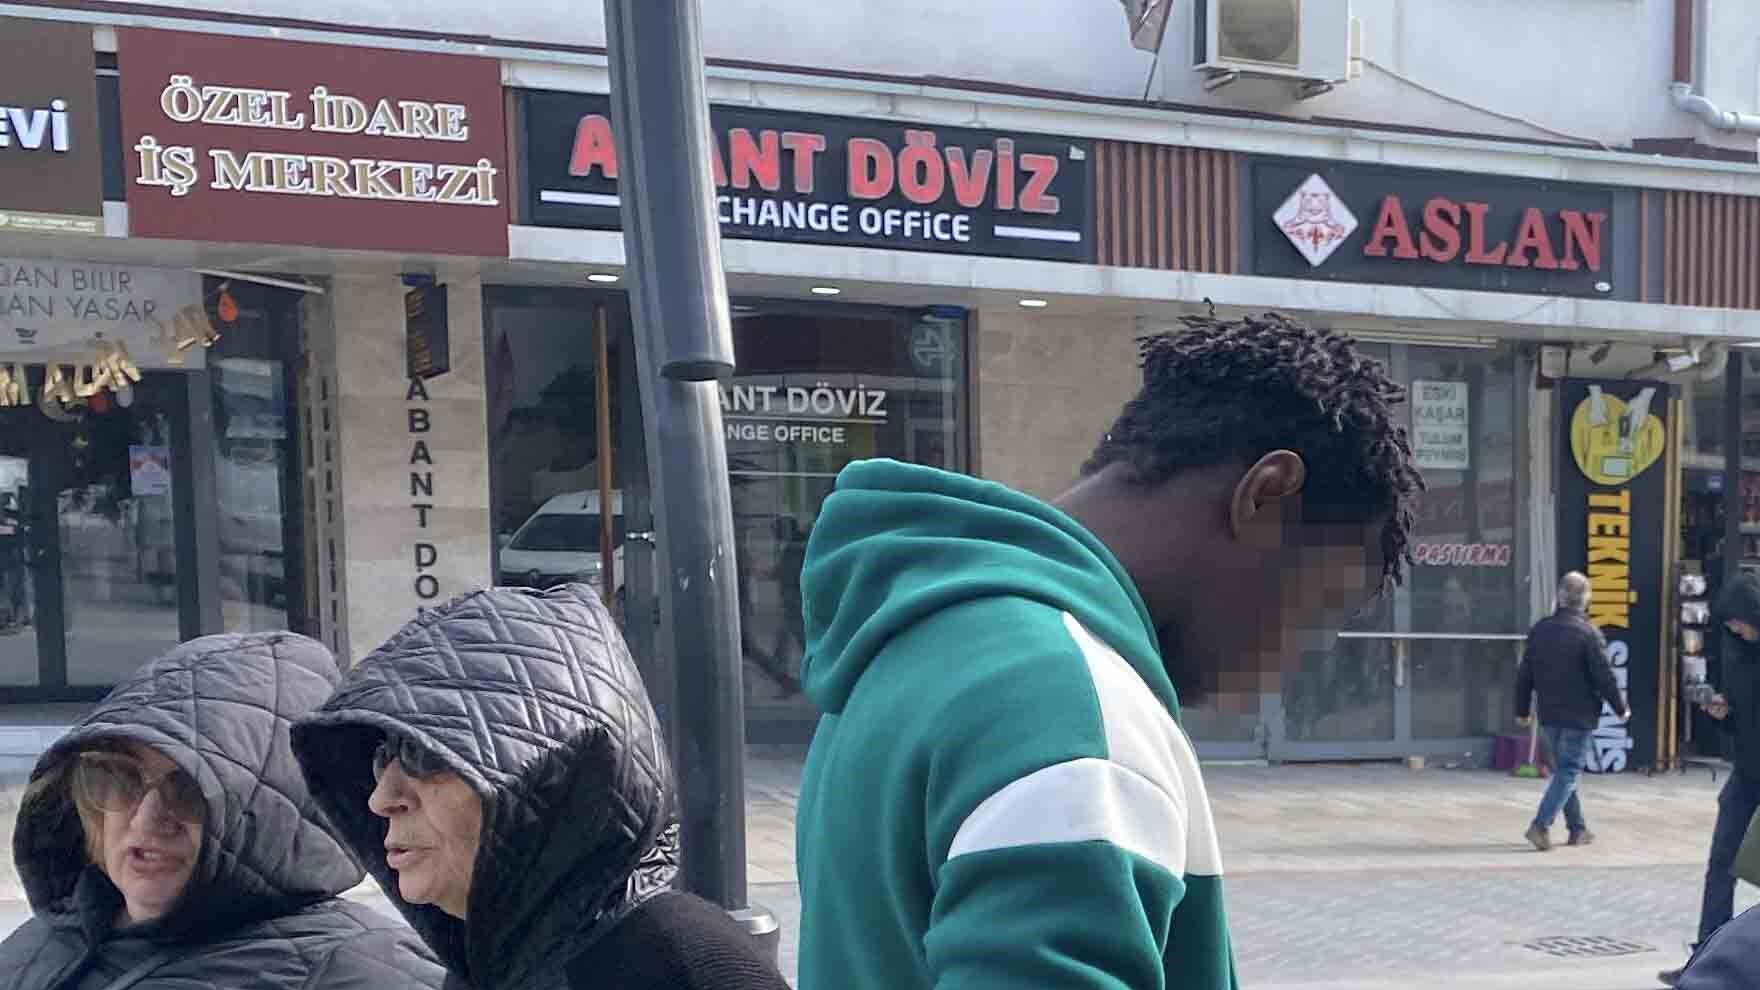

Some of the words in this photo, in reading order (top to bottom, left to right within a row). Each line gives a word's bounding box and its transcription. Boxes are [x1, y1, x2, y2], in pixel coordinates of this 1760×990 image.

[160, 75, 303, 131] ÖZEL
[309, 86, 468, 141] İDARE
[134, 135, 198, 196] İŞ
[208, 149, 500, 206] MERKEZİ
[568, 114, 827, 193] ANT
[848, 129, 1060, 214] DÖVİZ
[717, 195, 849, 231] CHANGE
[1363, 194, 1607, 271] ASLAN
[774, 425, 846, 443] OFFICE
[787, 382, 888, 417] DÖVİZ
[406, 377, 433, 528] ABANT
[1587, 489, 1638, 629] TEKNİK
